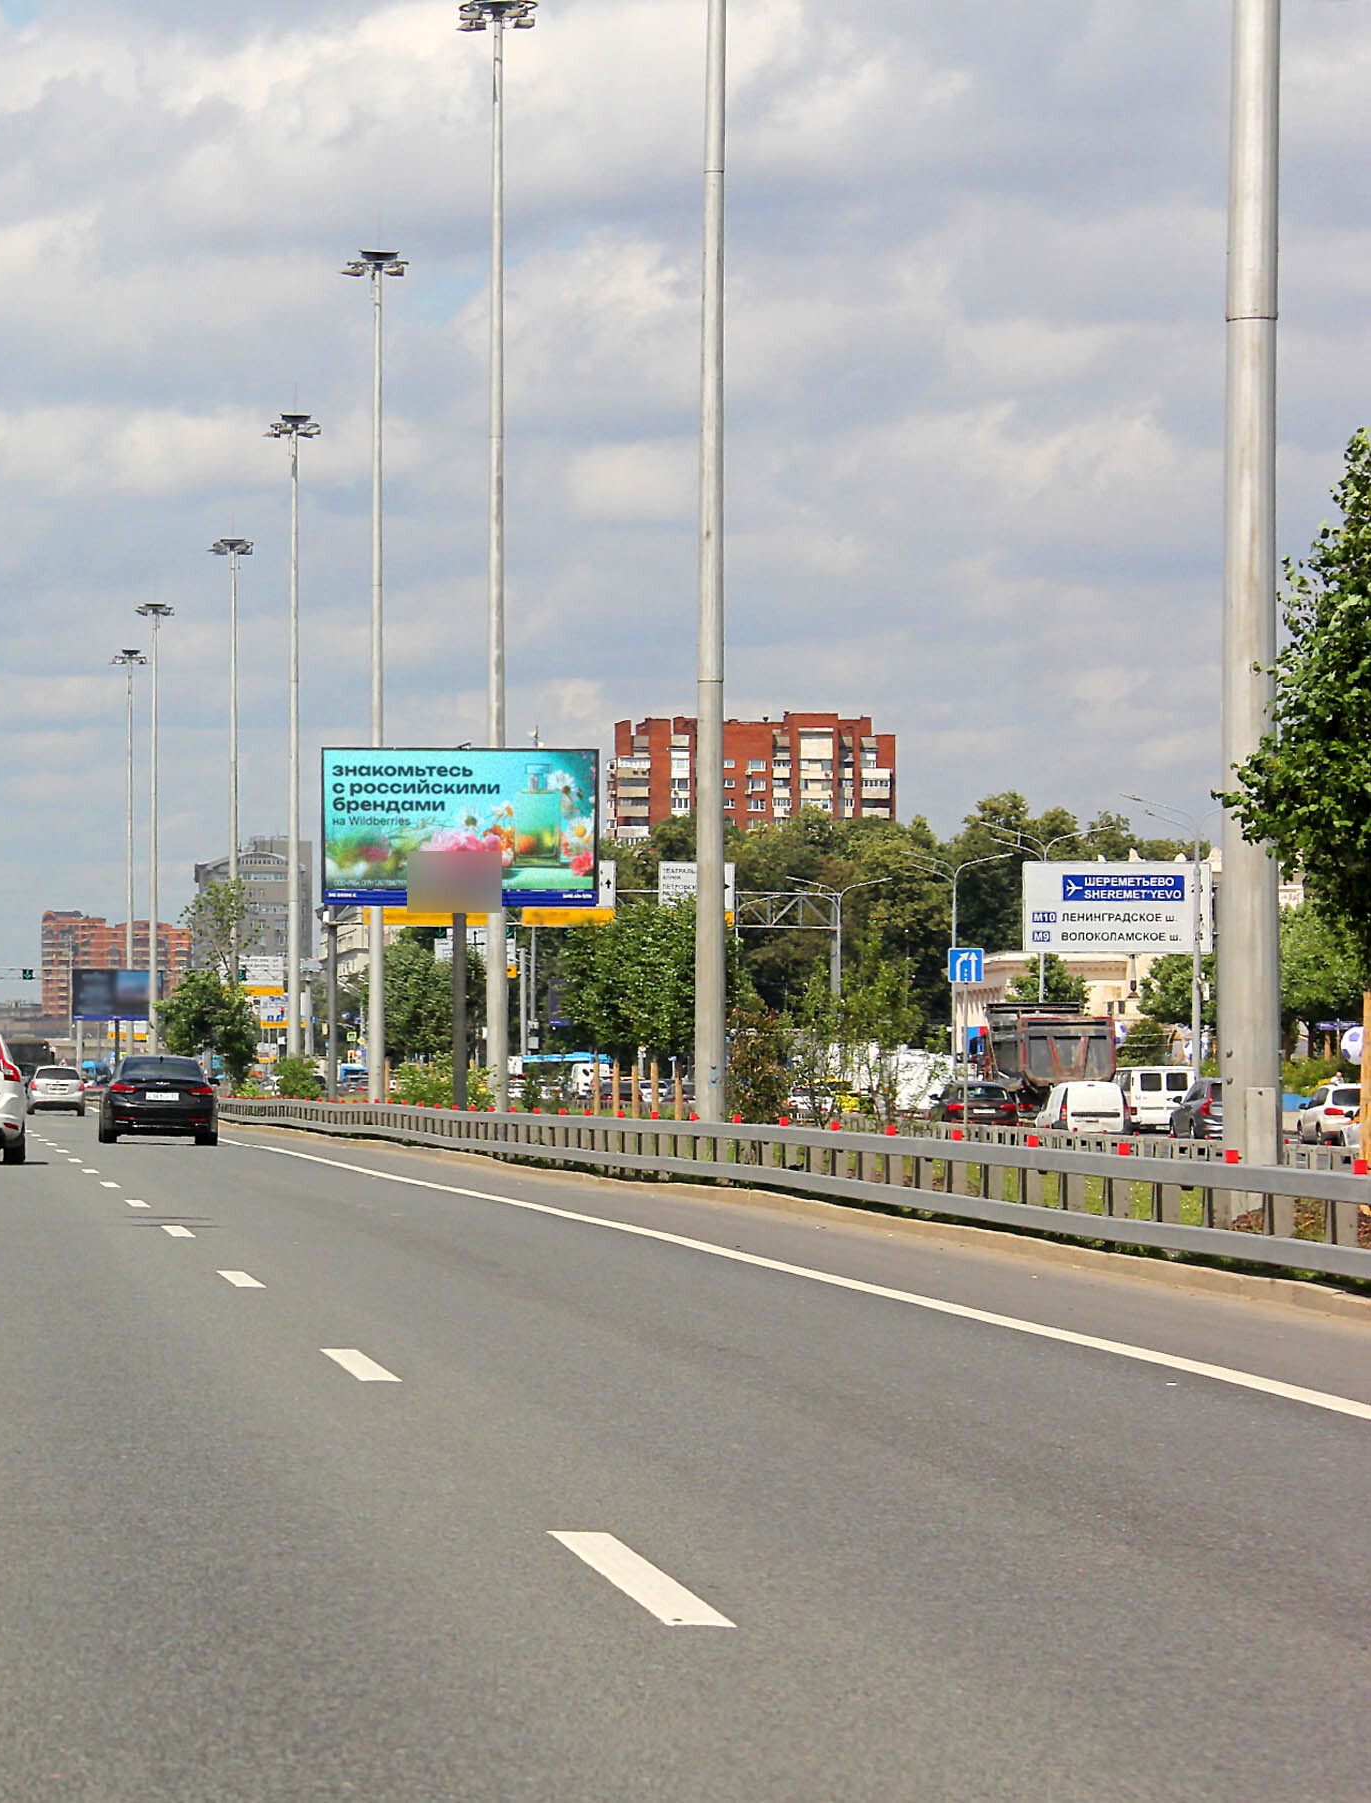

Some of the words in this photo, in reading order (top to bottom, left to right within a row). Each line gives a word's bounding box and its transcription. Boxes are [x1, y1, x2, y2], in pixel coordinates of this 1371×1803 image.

[332, 765, 473, 777] знакомьтесь
[332, 782, 345, 794] с
[349, 779, 500, 796] российскими
[332, 797, 445, 814] брендами
[332, 817, 346, 826] на
[349, 816, 411, 826] Wildberries
[1084, 877, 1175, 887] ШЕРЕМЕТЬЕВО
[1084, 890, 1182, 899] SHEREMET'YEVO
[1032, 913, 1056, 923] М10
[1061, 913, 1162, 924] ЛЕНИНГРАДСКОЕ
[1032, 932, 1050, 942] М9
[1061, 932, 1166, 942] ВОЛОКОЛАМСКОЕ
[1169, 934, 1182, 942] ш.
